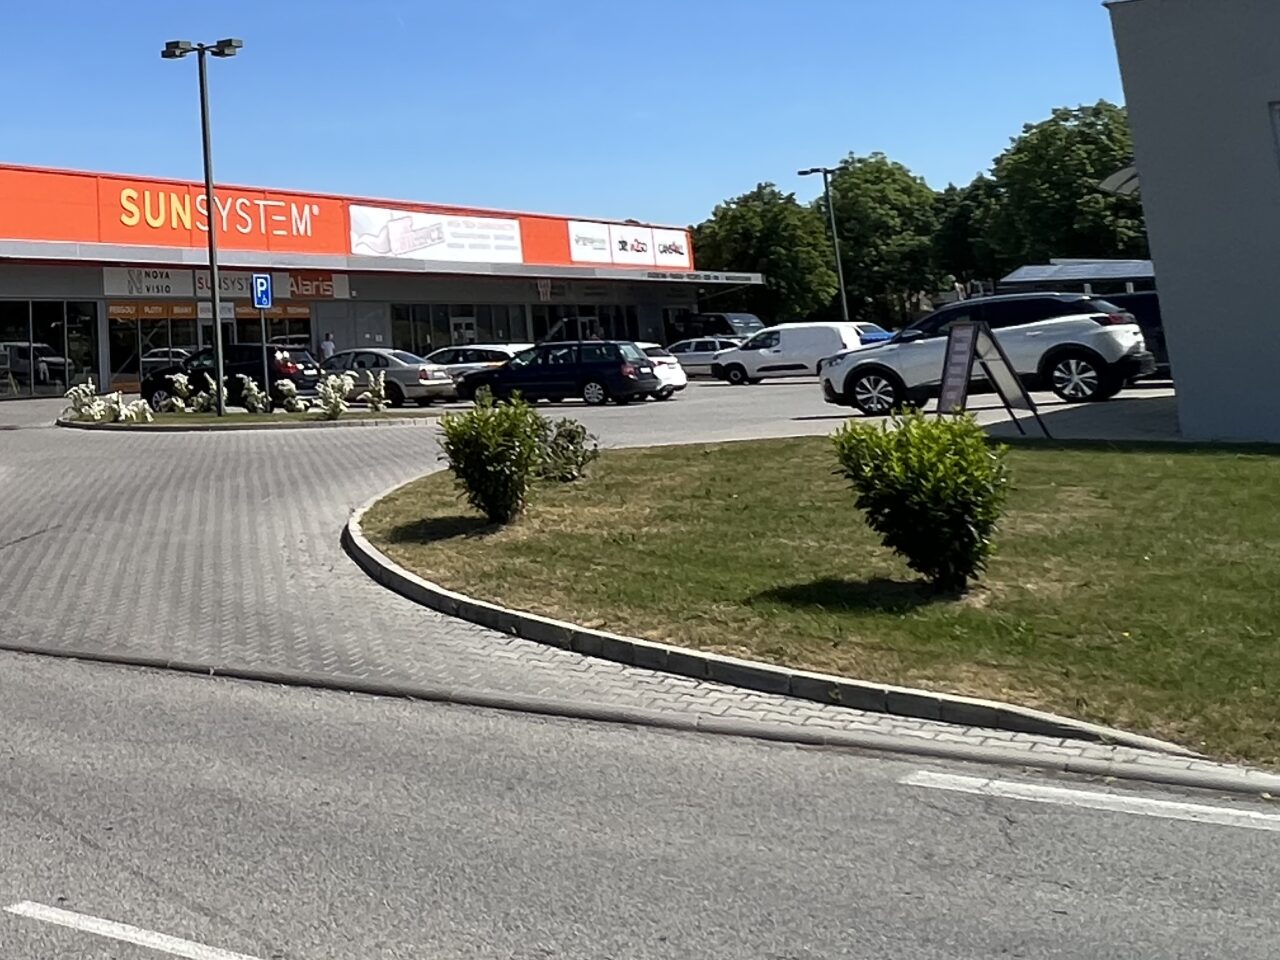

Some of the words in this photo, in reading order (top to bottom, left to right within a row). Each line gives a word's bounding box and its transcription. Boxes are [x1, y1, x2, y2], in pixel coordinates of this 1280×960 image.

[144, 270, 170, 279] NOVA
[256, 278, 267, 298] P
[289, 276, 333, 296] Alaris
